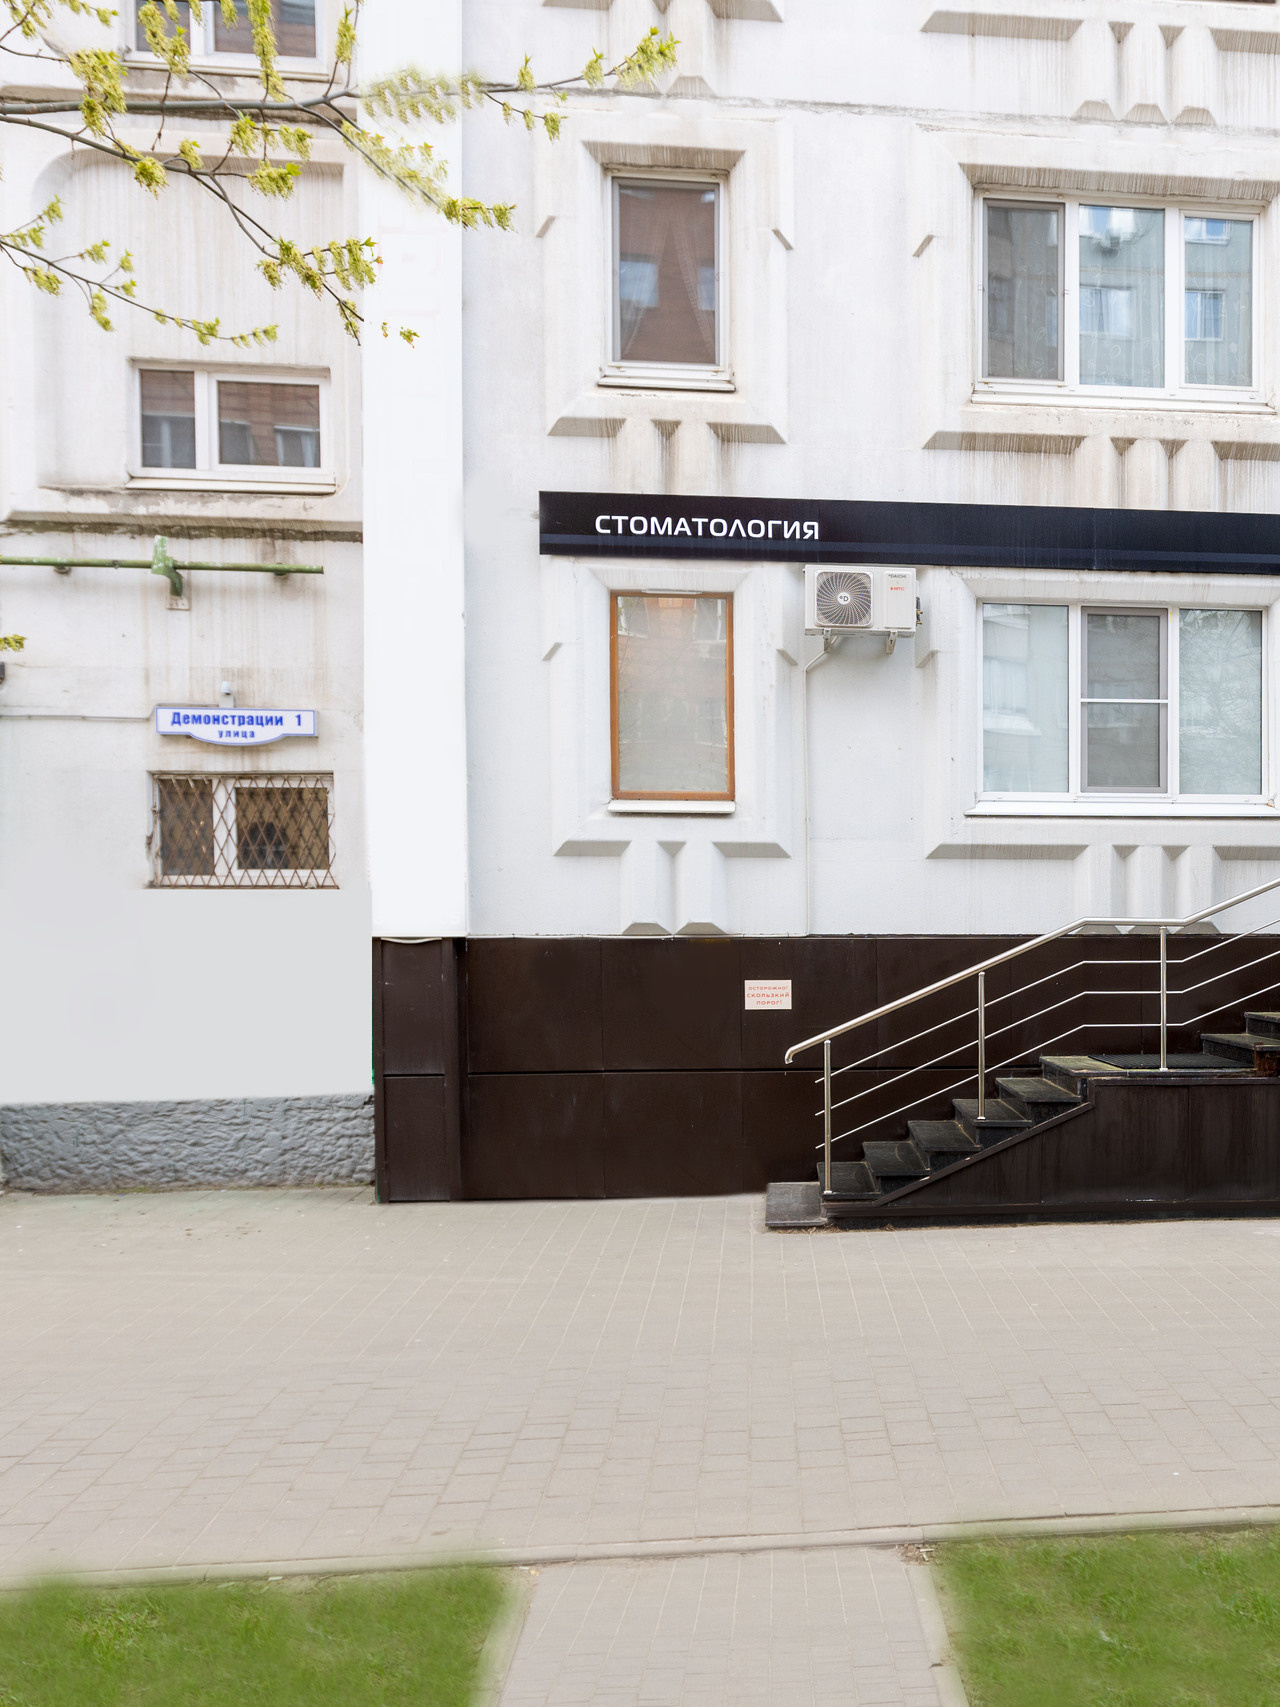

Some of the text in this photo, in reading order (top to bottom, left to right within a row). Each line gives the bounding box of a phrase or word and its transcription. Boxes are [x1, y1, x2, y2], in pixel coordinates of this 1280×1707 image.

[595, 514, 820, 540] СТОМАТОЛОГИЯ
[171, 712, 302, 727] Демонстрации 1
[218, 730, 255, 739] улица
